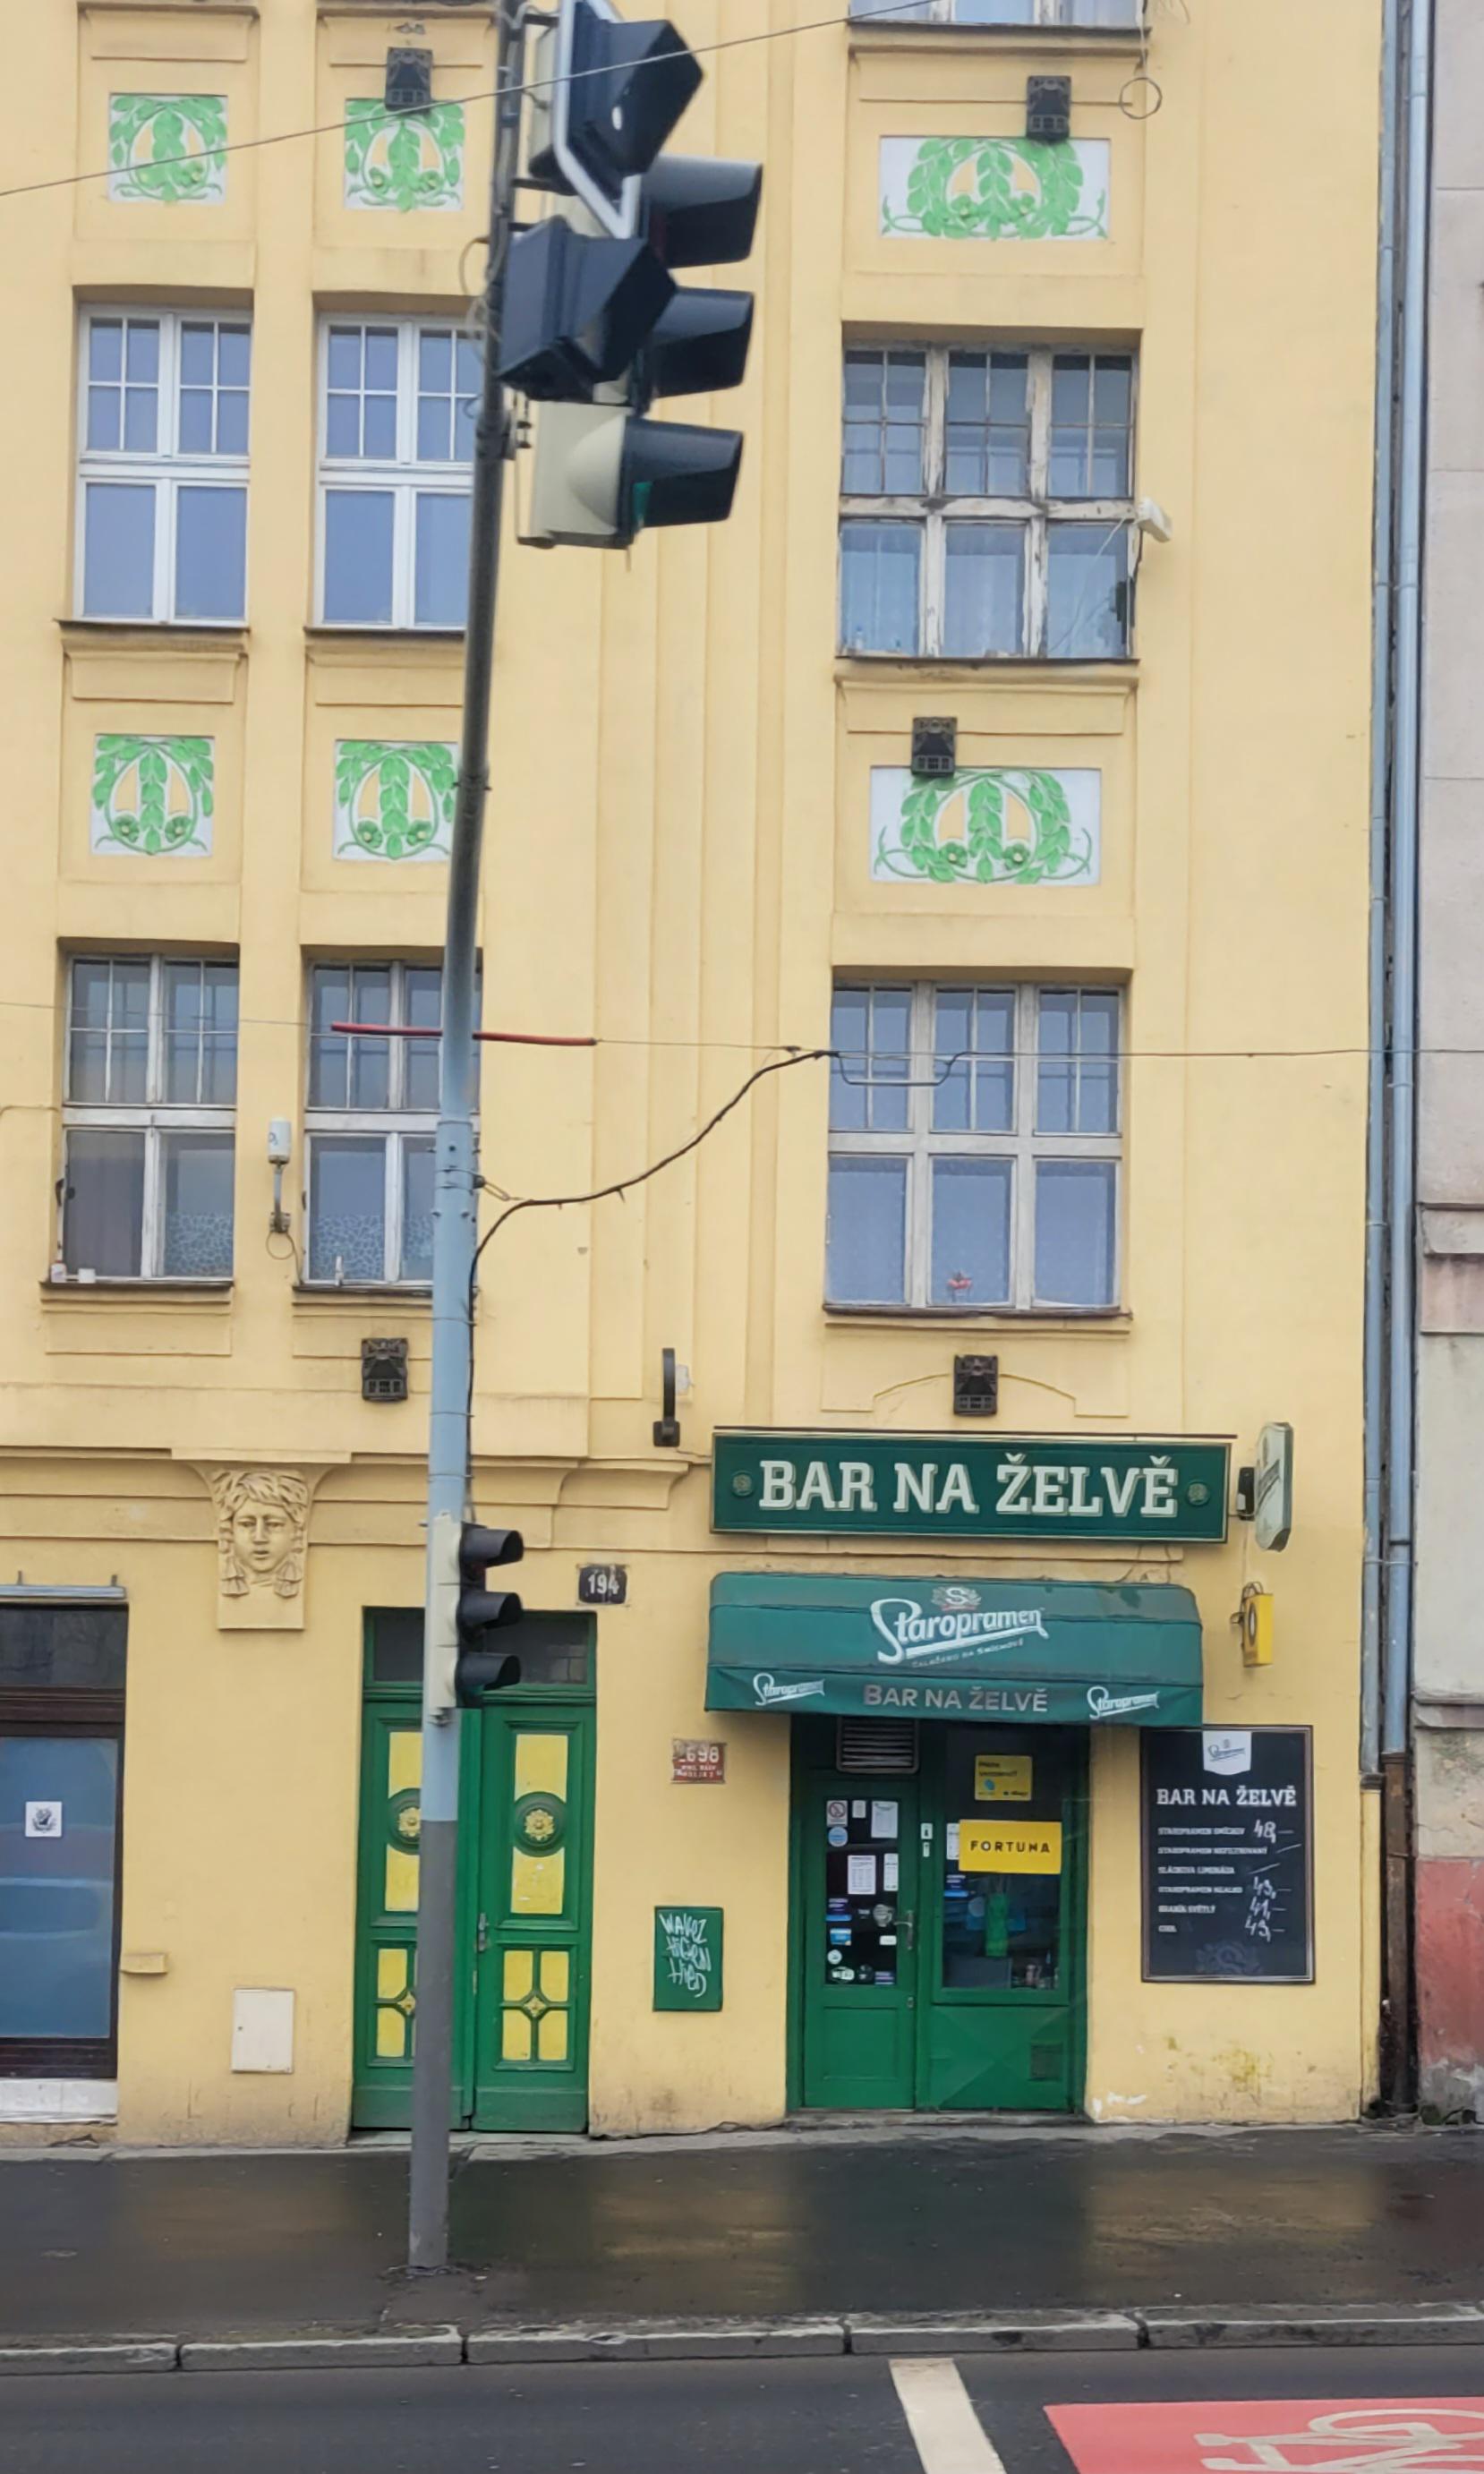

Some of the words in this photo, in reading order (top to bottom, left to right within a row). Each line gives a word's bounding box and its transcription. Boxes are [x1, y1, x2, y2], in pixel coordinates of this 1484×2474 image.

[758, 1460, 877, 1513] BAR
[893, 1462, 979, 1514] NA
[995, 1452, 1179, 1519] ŽELVĚ
[588, 1574, 620, 1595] 194
[870, 1598, 1050, 1665] Staropramen
[864, 1684, 918, 1707] BAR
[925, 1688, 962, 1710] NA
[968, 1685, 1048, 1712] ŽELVĚ
[1156, 1788, 1197, 1806] BAR
[1202, 1788, 1231, 1806] NA
[1236, 1785, 1297, 1807] ŽELVĚ
[969, 1840, 1051, 1854] FORTUNA
